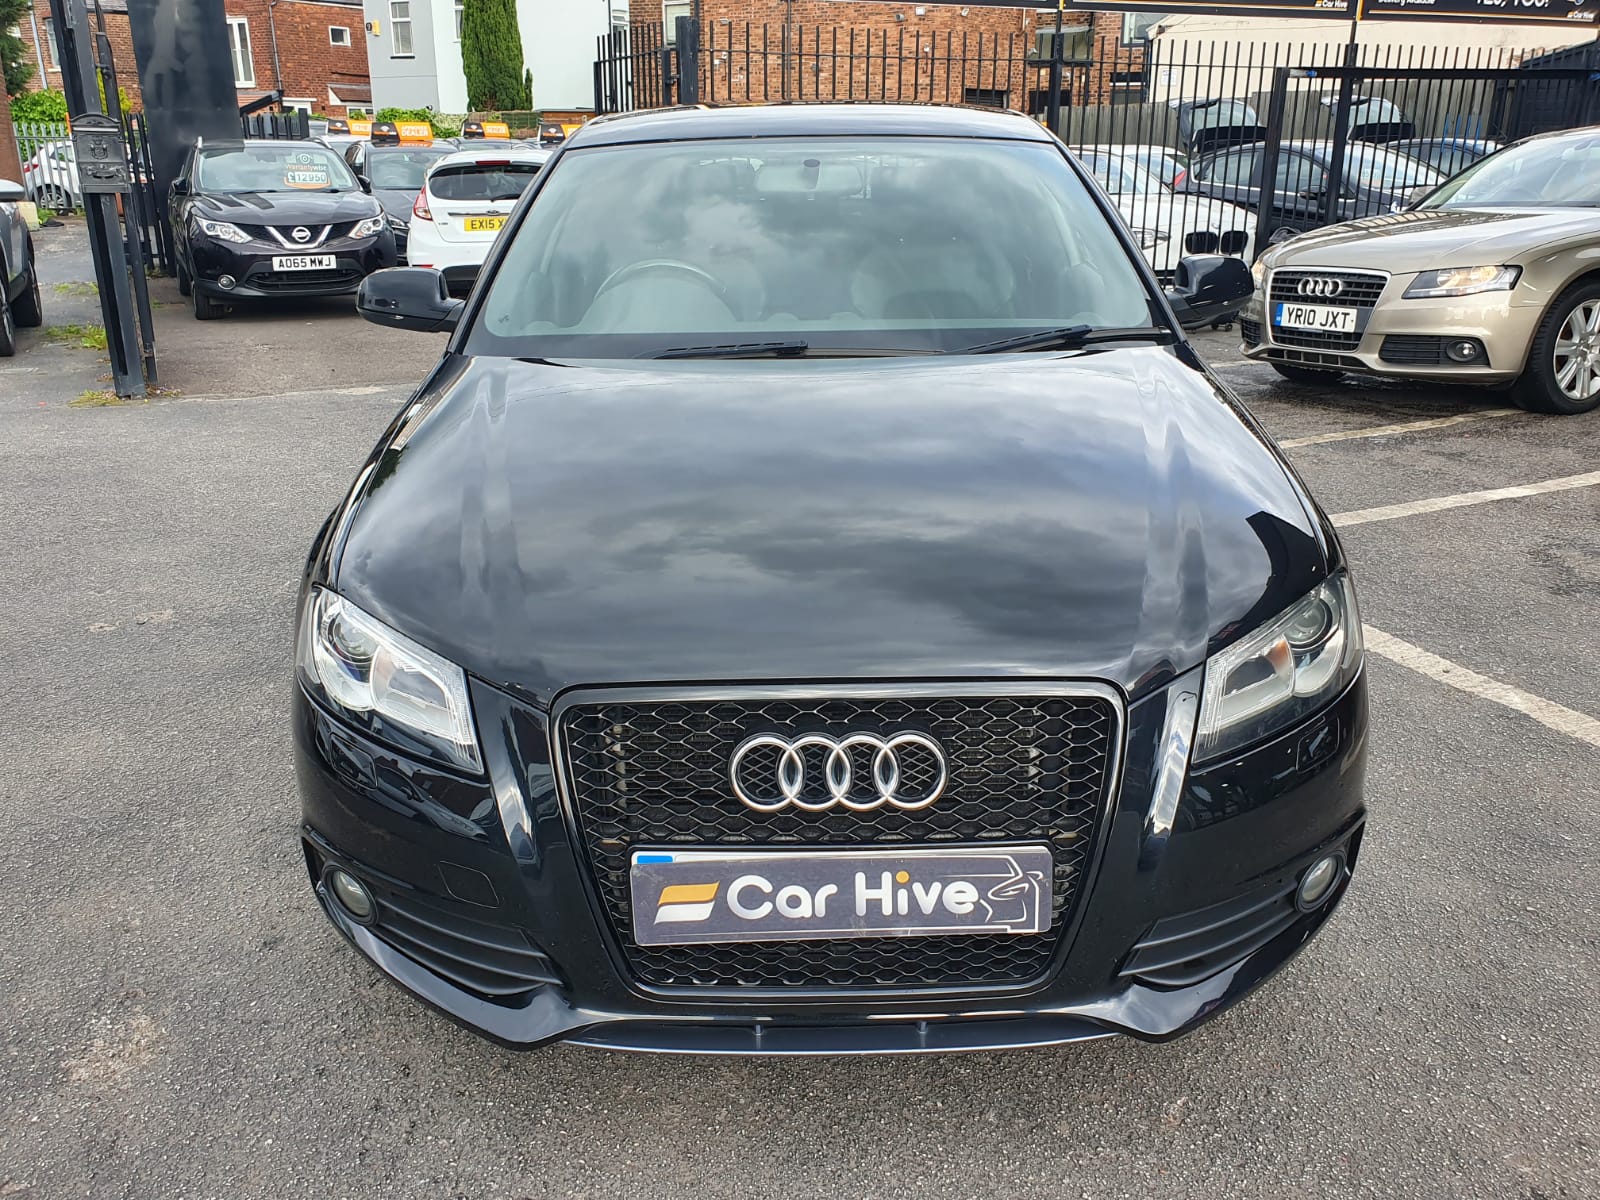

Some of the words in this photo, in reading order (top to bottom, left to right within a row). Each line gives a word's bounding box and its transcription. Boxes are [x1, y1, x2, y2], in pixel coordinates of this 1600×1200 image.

[402, 129, 429, 137] DEALER
[470, 219, 495, 230] EX15
[309, 256, 331, 267] MWJ
[1287, 306, 1316, 326] YR10
[1320, 310, 1350, 329] JXT
[726, 874, 838, 920] Car
[854, 870, 979, 916] Hive
